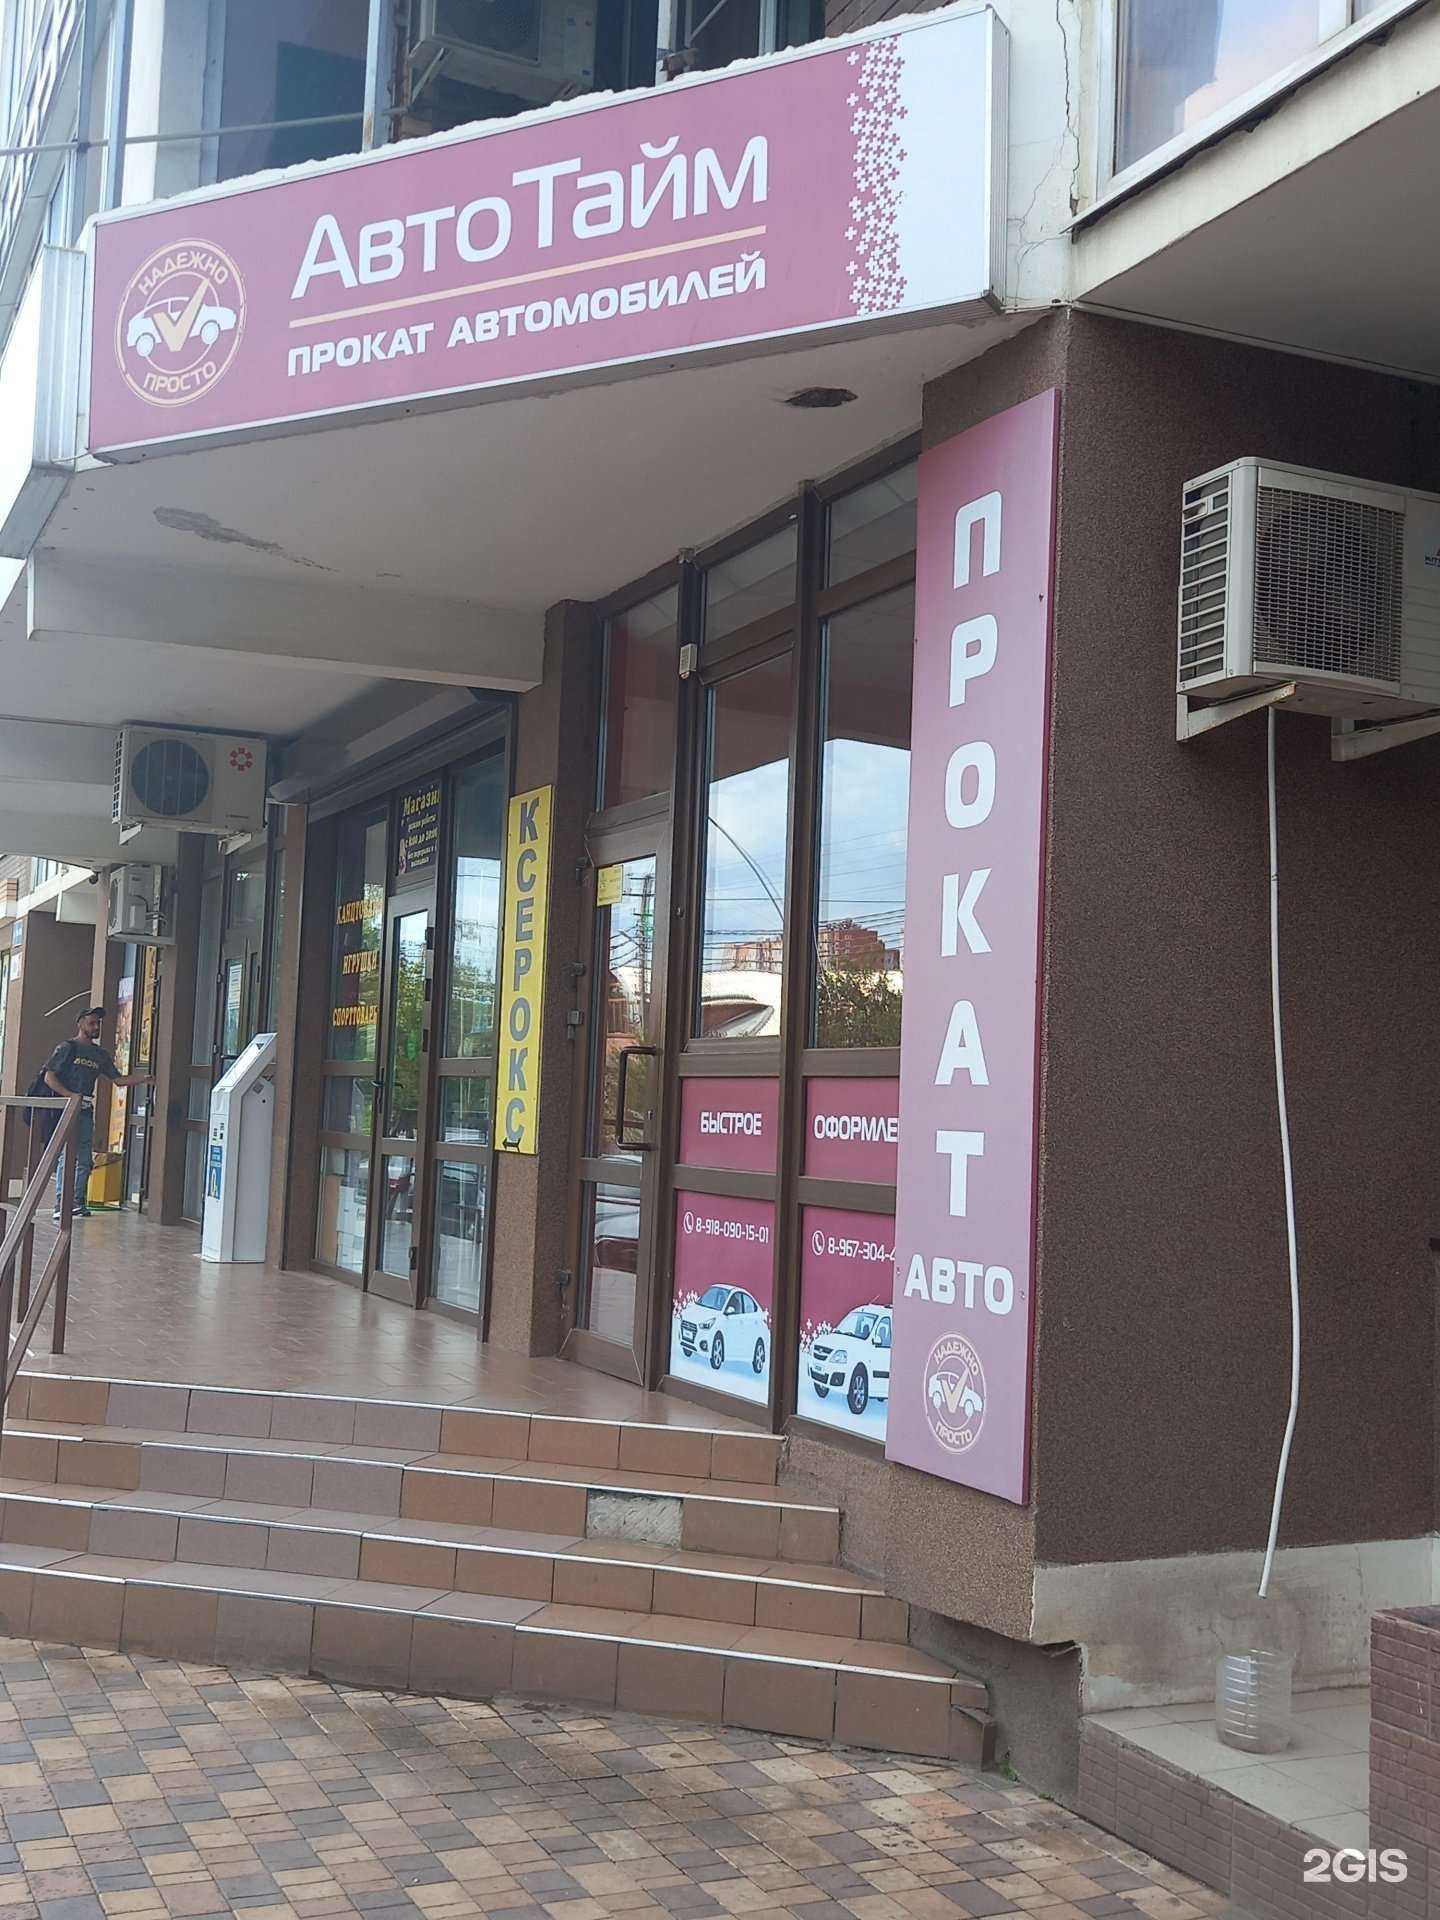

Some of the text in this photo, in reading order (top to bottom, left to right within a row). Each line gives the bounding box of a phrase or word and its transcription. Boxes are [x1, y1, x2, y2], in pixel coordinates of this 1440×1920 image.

[138, 250, 229, 296] НАДЕЖНО
[287, 249, 767, 377] ПРОКАТ АВТОМОБИЛЕЙ
[143, 360, 218, 393] ПРОСТО
[934, 490, 1003, 1218] ПРОКАТ
[505, 798, 541, 1142] КСЕРОКС
[700, 1111, 762, 1136] БЫСТРОЕ
[695, 1216, 769, 1244] 8-918-090-15-01
[903, 1253, 1015, 1316] АВТО
[933, 1341, 980, 1376] НАДЕЖНО
[935, 1420, 973, 1445] ПРОСТО
